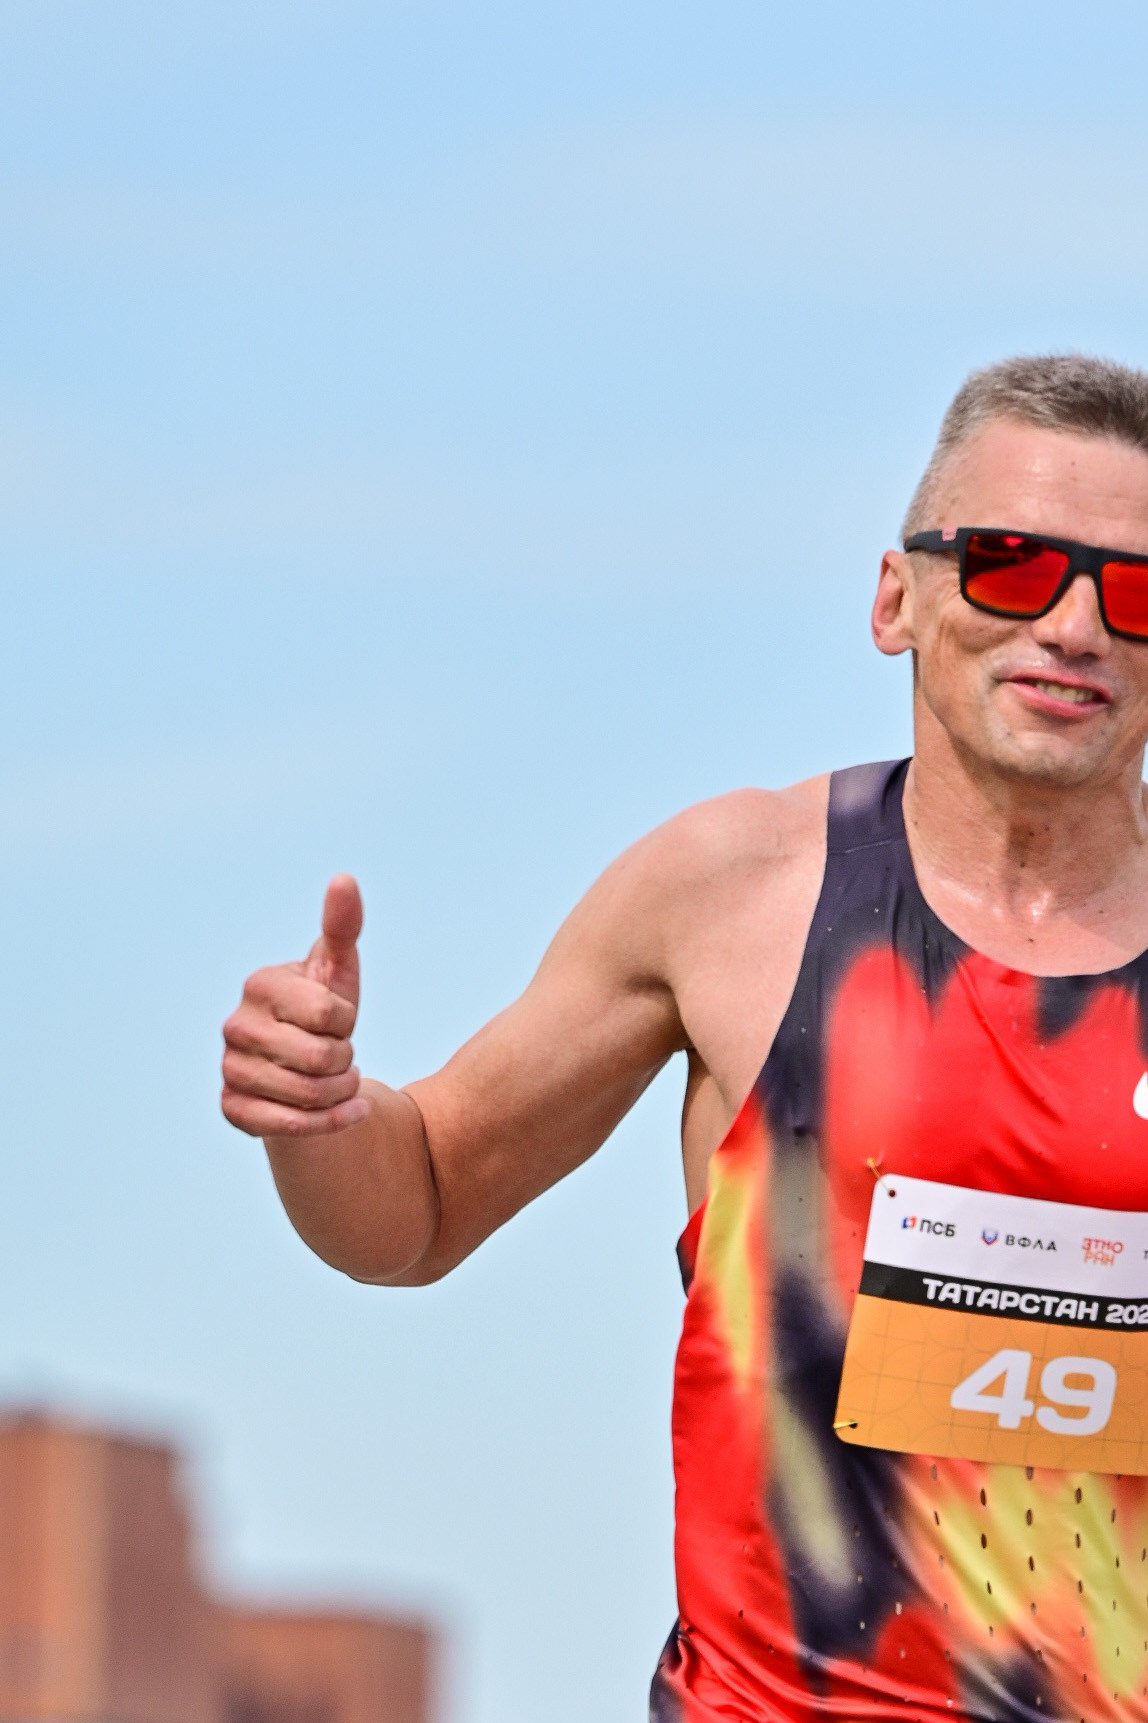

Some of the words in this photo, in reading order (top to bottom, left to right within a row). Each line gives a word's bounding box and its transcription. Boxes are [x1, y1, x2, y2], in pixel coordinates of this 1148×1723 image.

[920, 1219, 956, 1238] ПСБ
[1005, 1235, 1058, 1251] ВФЛА
[922, 1278, 1099, 1322] ТАТАРСТАН
[951, 1348, 1118, 1435] 49
